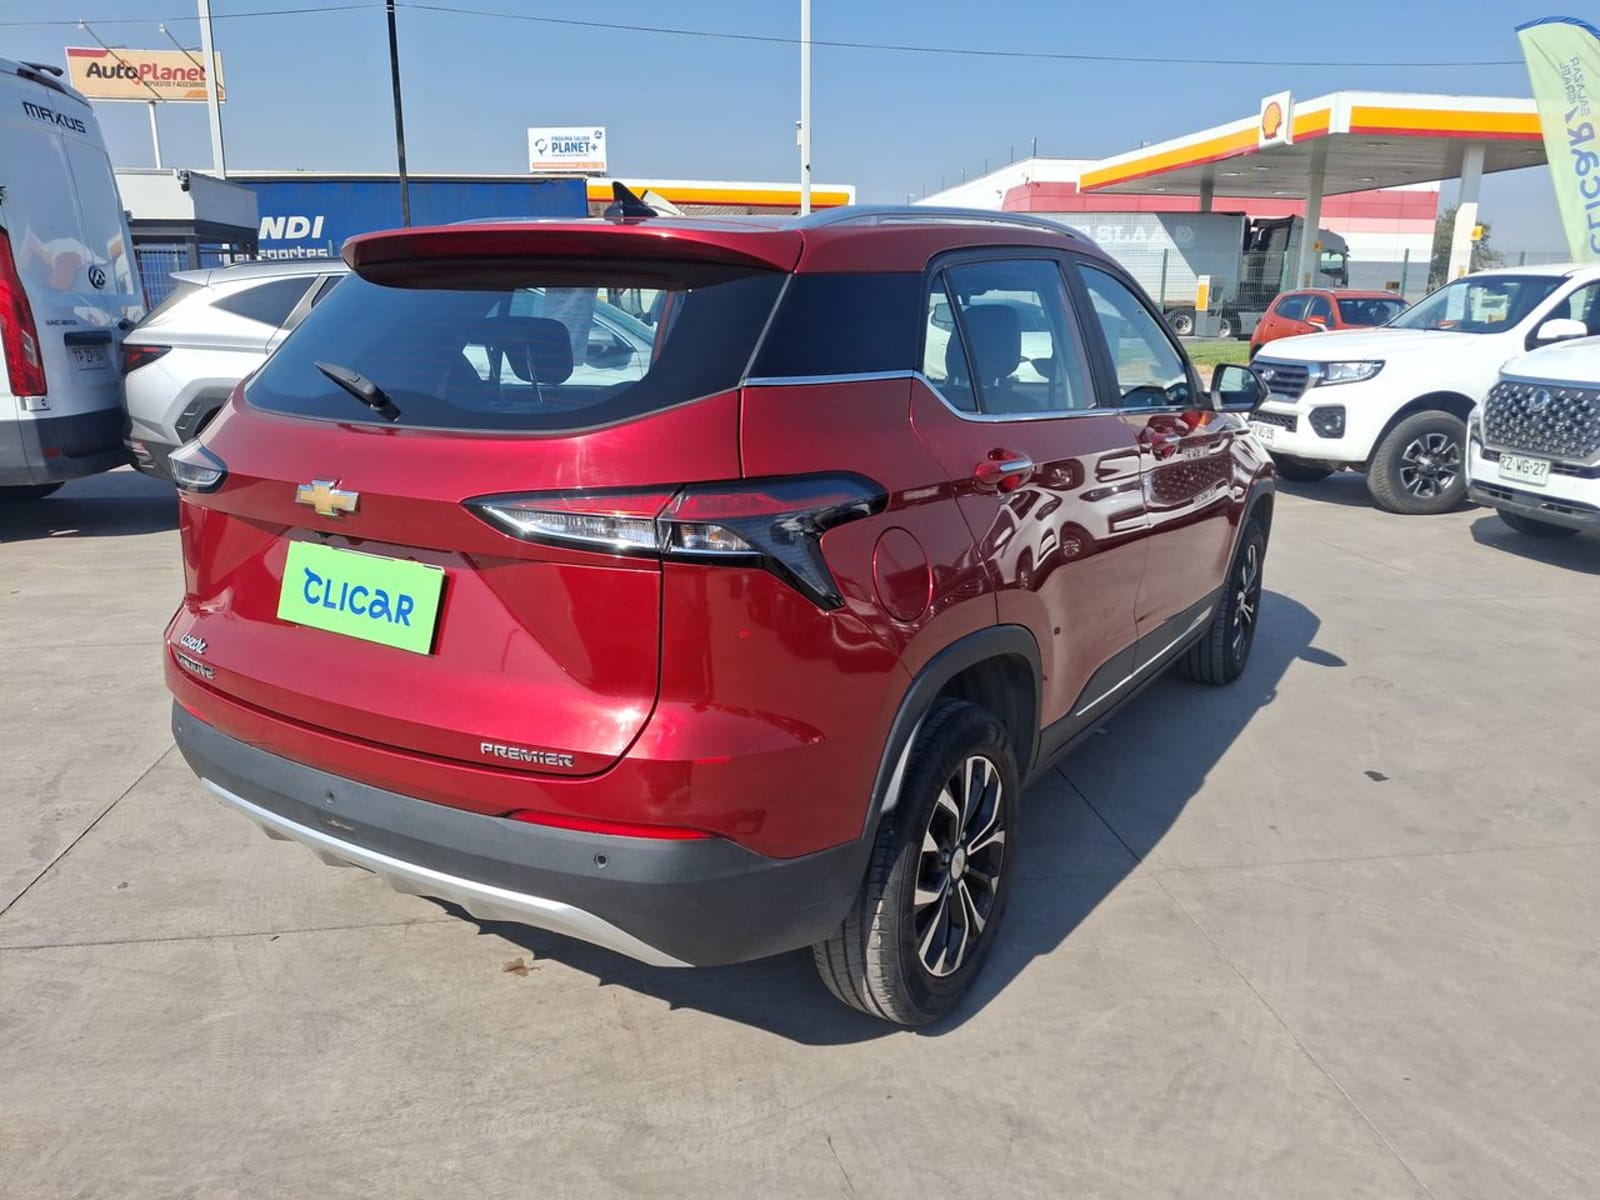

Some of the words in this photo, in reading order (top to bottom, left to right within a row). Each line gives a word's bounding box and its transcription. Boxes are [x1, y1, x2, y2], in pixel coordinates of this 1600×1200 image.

[86, 61, 206, 81] AutoPlanet
[22, 100, 86, 134] MAXUS
[480, 742, 574, 767] PREMIER
